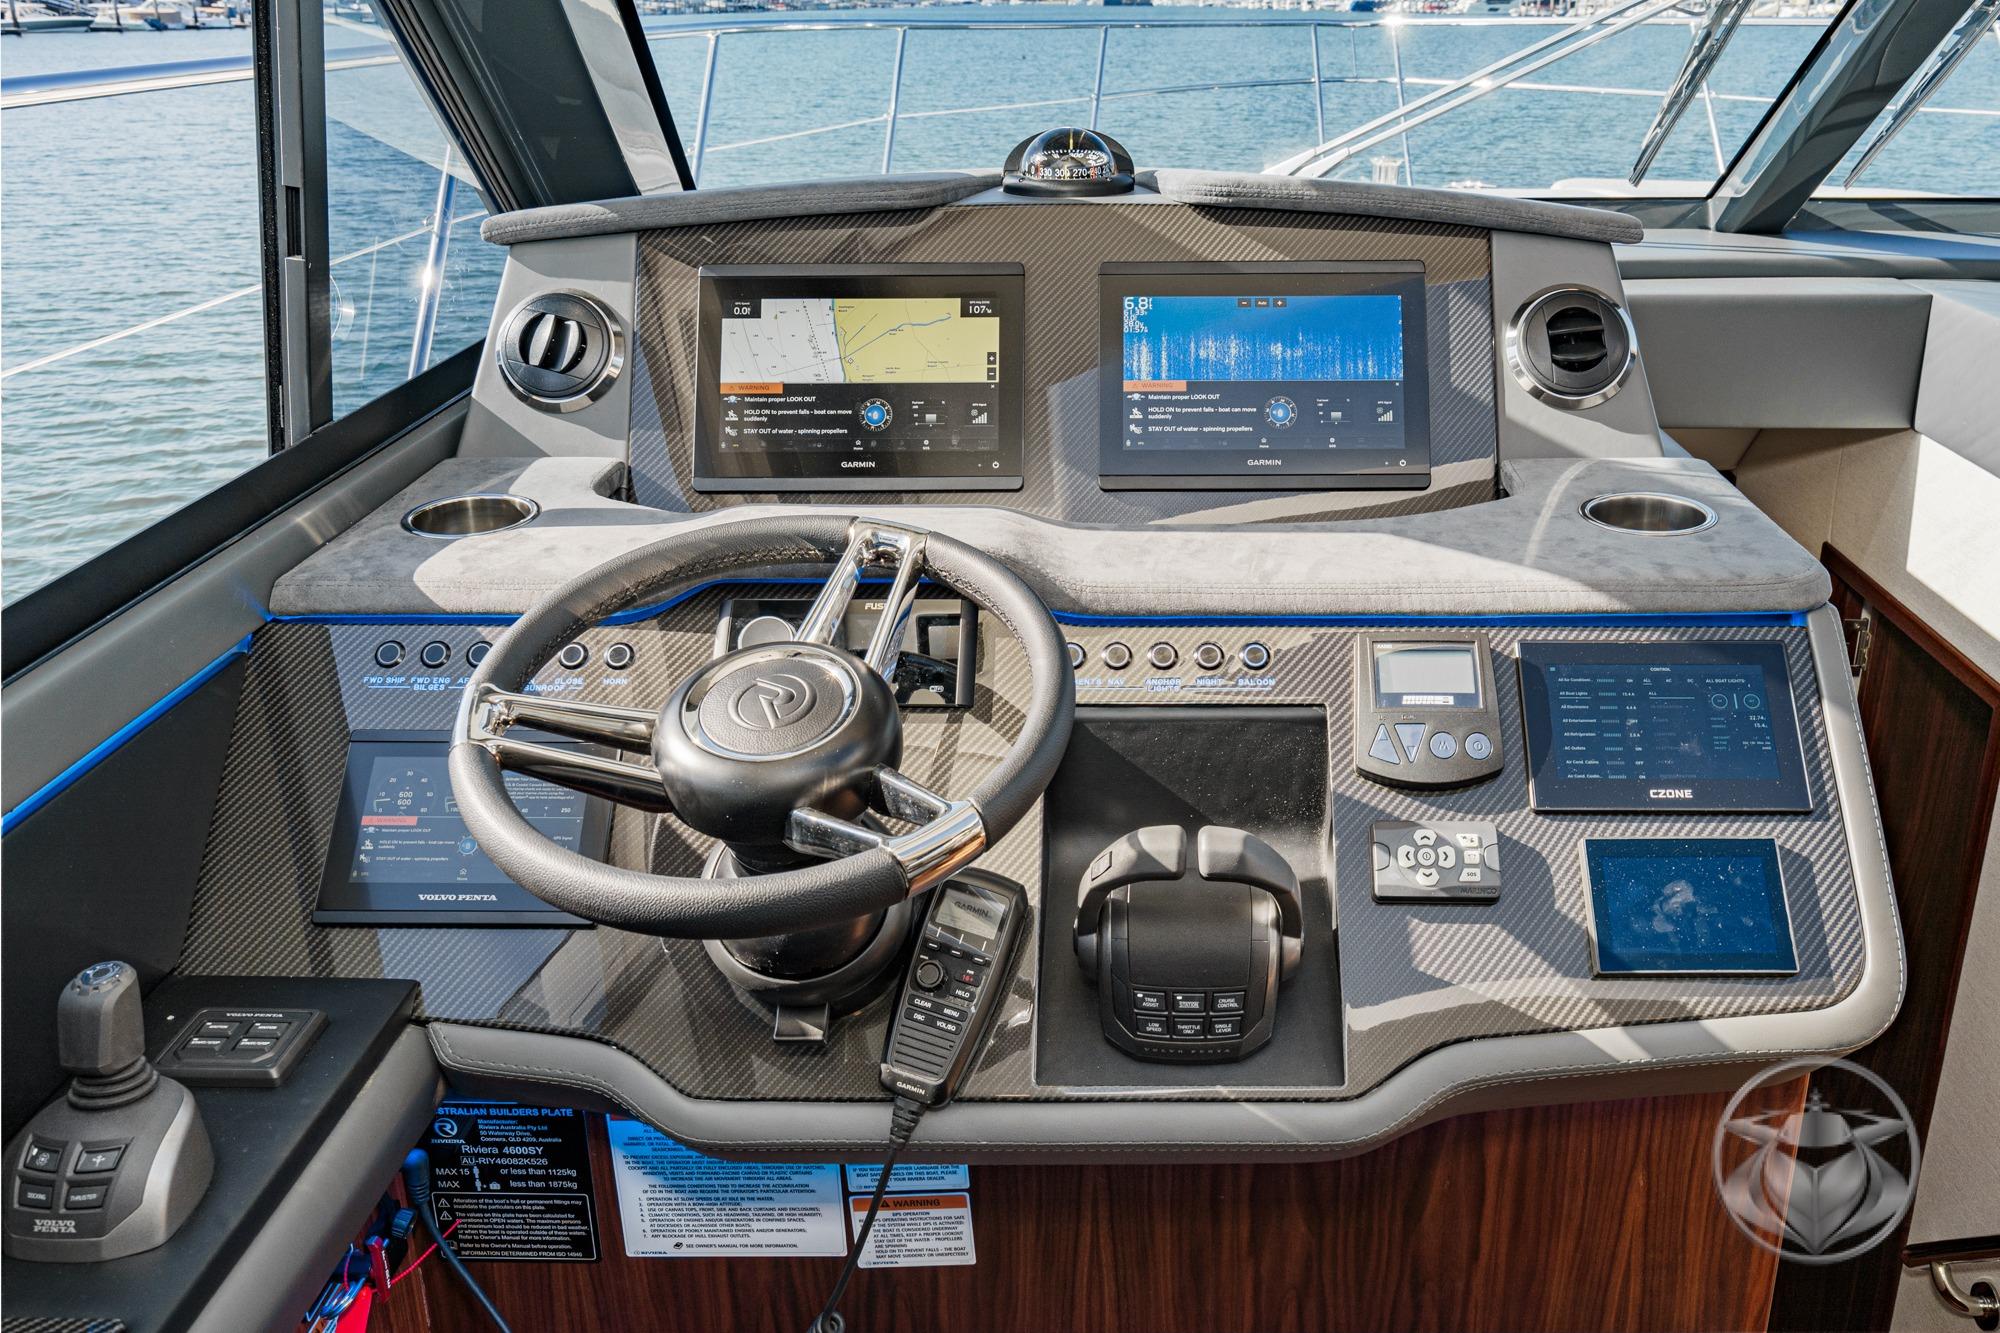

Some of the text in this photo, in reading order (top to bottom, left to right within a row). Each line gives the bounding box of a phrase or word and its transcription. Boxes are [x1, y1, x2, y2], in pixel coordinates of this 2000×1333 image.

[1039, 169, 1052, 177] 330
[1073, 169, 1087, 177] 270
[969, 305, 986, 314] 107
[1650, 789, 1693, 798] CZONE
[954, 901, 989, 917] GARMIN
[914, 998, 932, 1008] CLEAR
[913, 1013, 925, 1021] DSC
[944, 1008, 960, 1017] MENU
[896, 1081, 925, 1095] GARMIN
[436, 1107, 573, 1117] STRALIAN BUILDERS PLATE
[462, 1146, 544, 1155] Riviera 4600SY
[548, 1169, 577, 1177] 1125kg
[548, 1181, 578, 1189] 1875kg
[893, 1199, 940, 1207] WARNING
[34, 1219, 75, 1227] VOLVO
